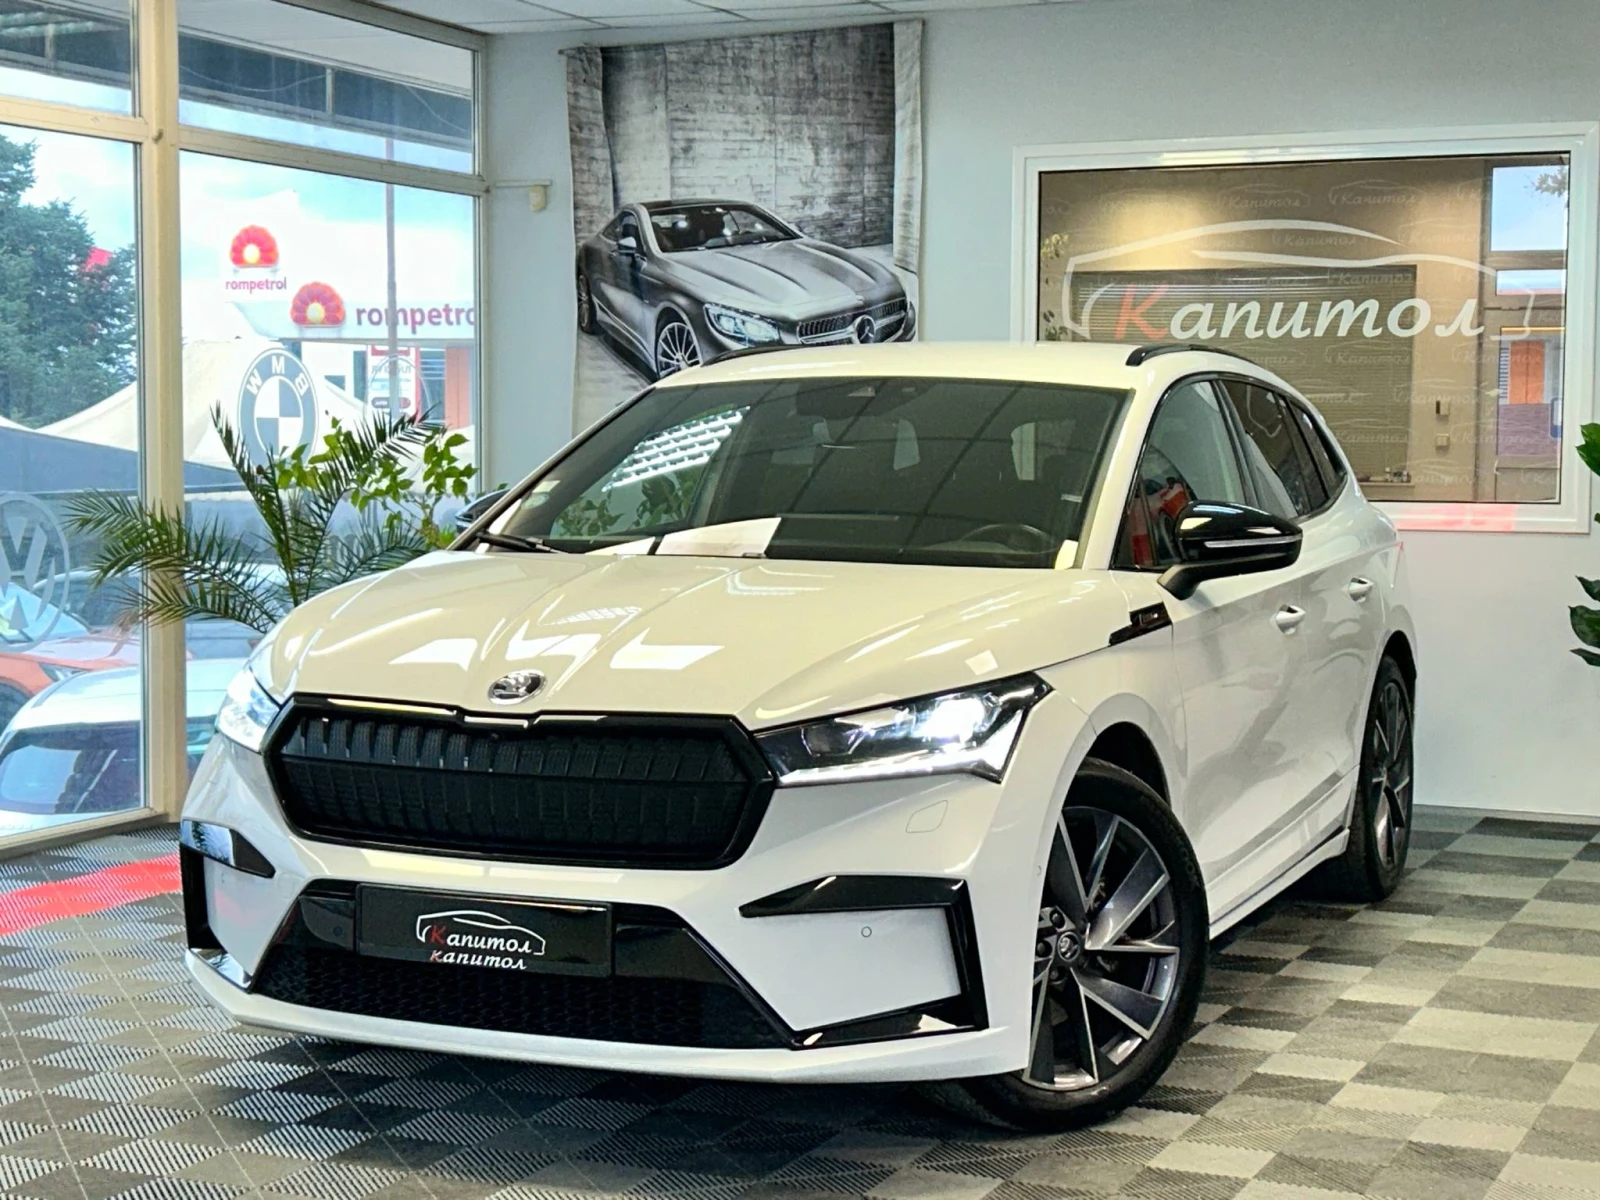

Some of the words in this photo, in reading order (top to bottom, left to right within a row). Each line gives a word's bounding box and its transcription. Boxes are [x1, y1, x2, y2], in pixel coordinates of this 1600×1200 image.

[225, 276, 287, 294] rompetrol
[1114, 280, 1485, 341] Капитол
[430, 925, 532, 954] Капитол
